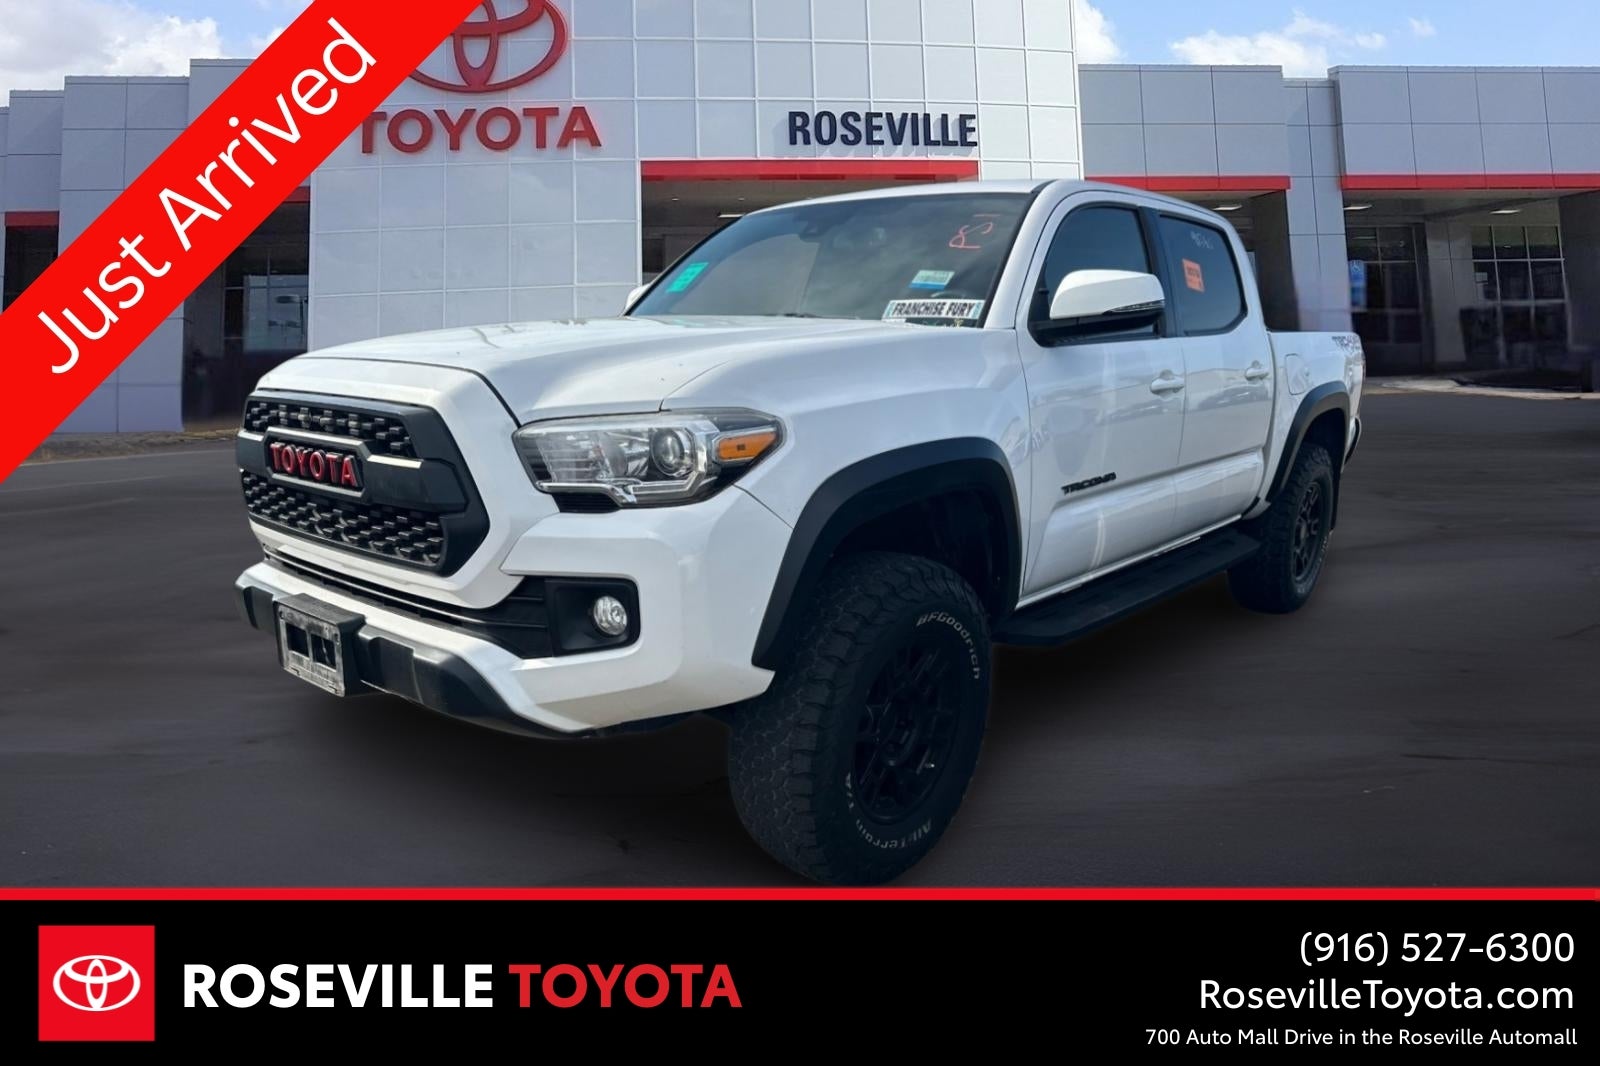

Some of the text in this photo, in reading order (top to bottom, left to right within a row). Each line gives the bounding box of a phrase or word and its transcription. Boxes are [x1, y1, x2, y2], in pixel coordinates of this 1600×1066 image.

[361, 106, 602, 154] TOYOTA
[788, 110, 979, 148] ROSEVILLE
[892, 302, 975, 317] FRANCHISE FURY
[270, 441, 357, 488] TOYOTA
[916, 611, 980, 680] BFGoodrich
